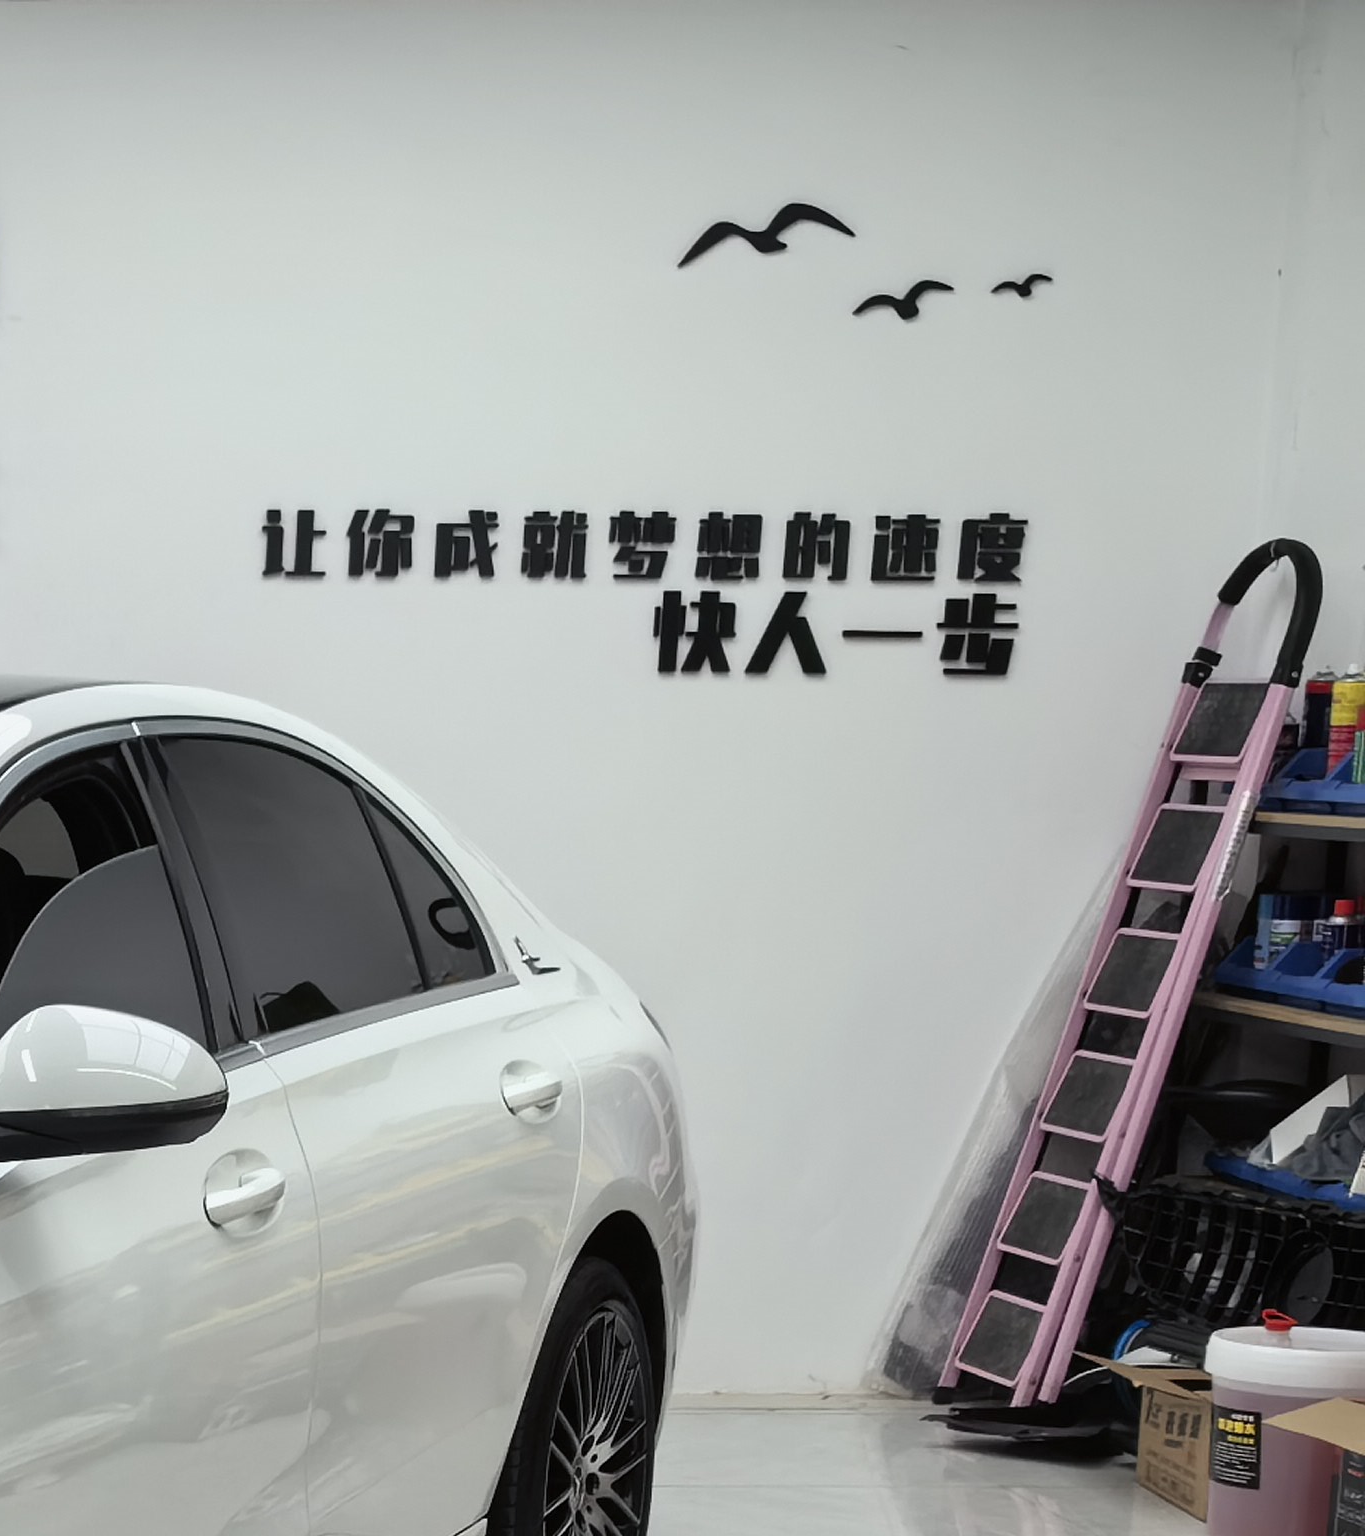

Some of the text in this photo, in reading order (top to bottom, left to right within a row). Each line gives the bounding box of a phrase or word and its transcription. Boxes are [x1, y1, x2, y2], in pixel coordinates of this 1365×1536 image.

[262, 508, 1028, 582] 让你成就梦想的速度
[653, 590, 1019, 676] 快人一步
